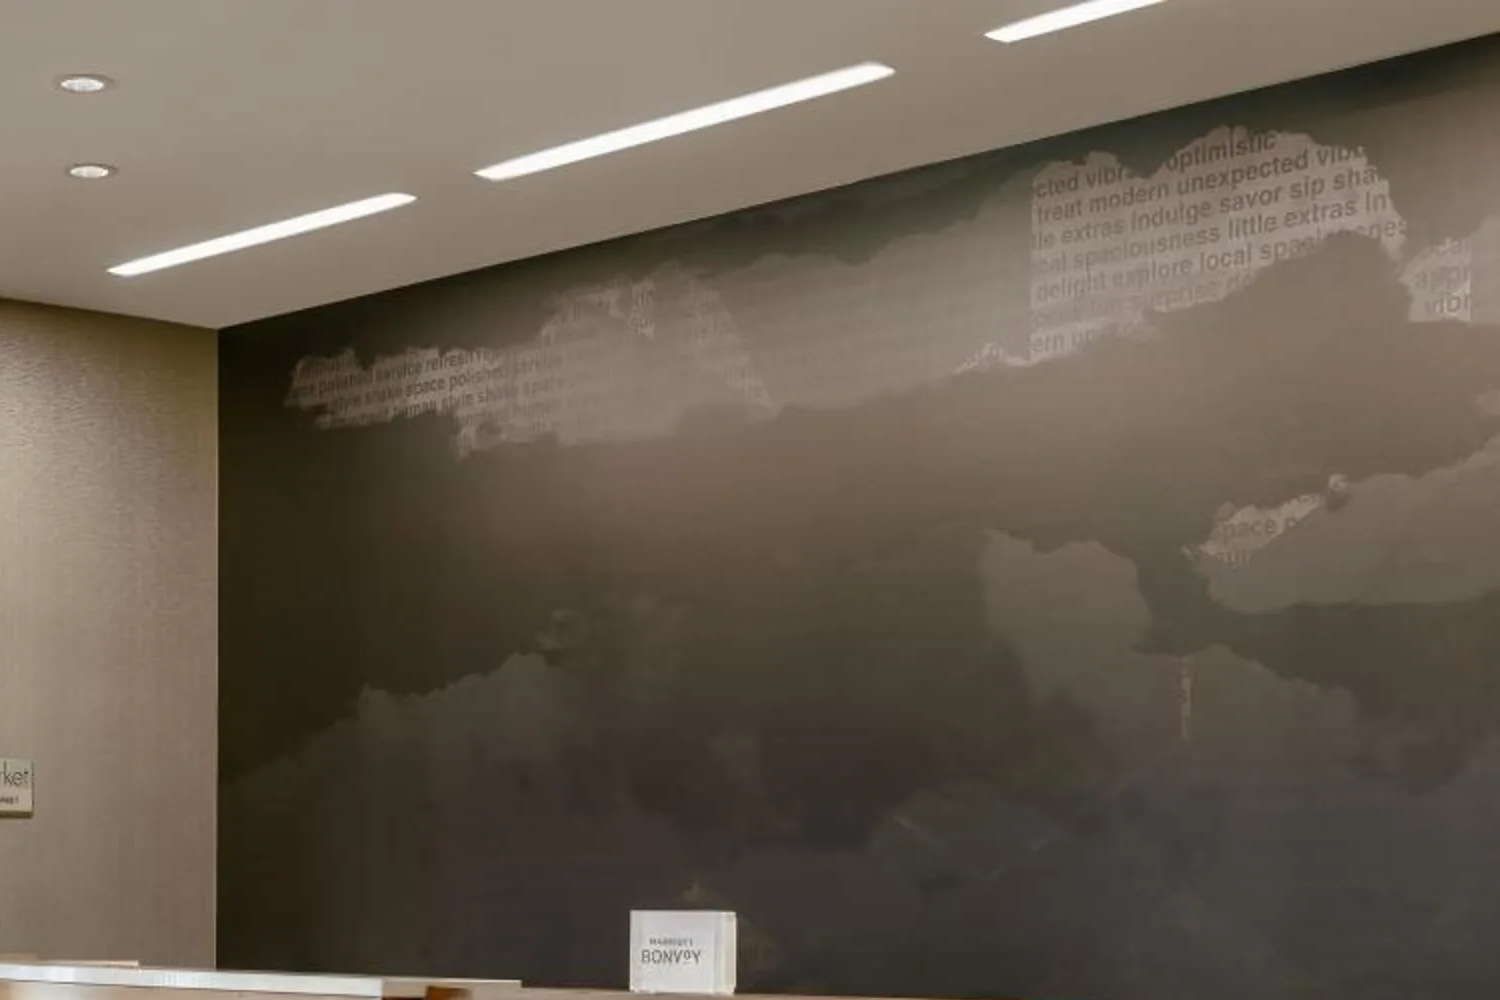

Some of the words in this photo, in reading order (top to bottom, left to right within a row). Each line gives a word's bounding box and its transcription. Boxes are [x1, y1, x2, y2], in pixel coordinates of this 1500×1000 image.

[1089, 182, 1170, 214] modern
[1177, 148, 1309, 196] unexpected
[1165, 126, 1277, 175] optimistic
[1061, 218, 1125, 244] extras
[1130, 201, 1213, 234] indulge
[1220, 185, 1284, 214] savor
[1289, 175, 1326, 201] sip
[1072, 225, 1221, 273] spaciousness
[1227, 213, 1278, 242] little
[1283, 198, 1358, 229] extras
[1036, 268, 1107, 303] delight
[1111, 257, 1195, 292] explore
[1199, 242, 1253, 273] local
